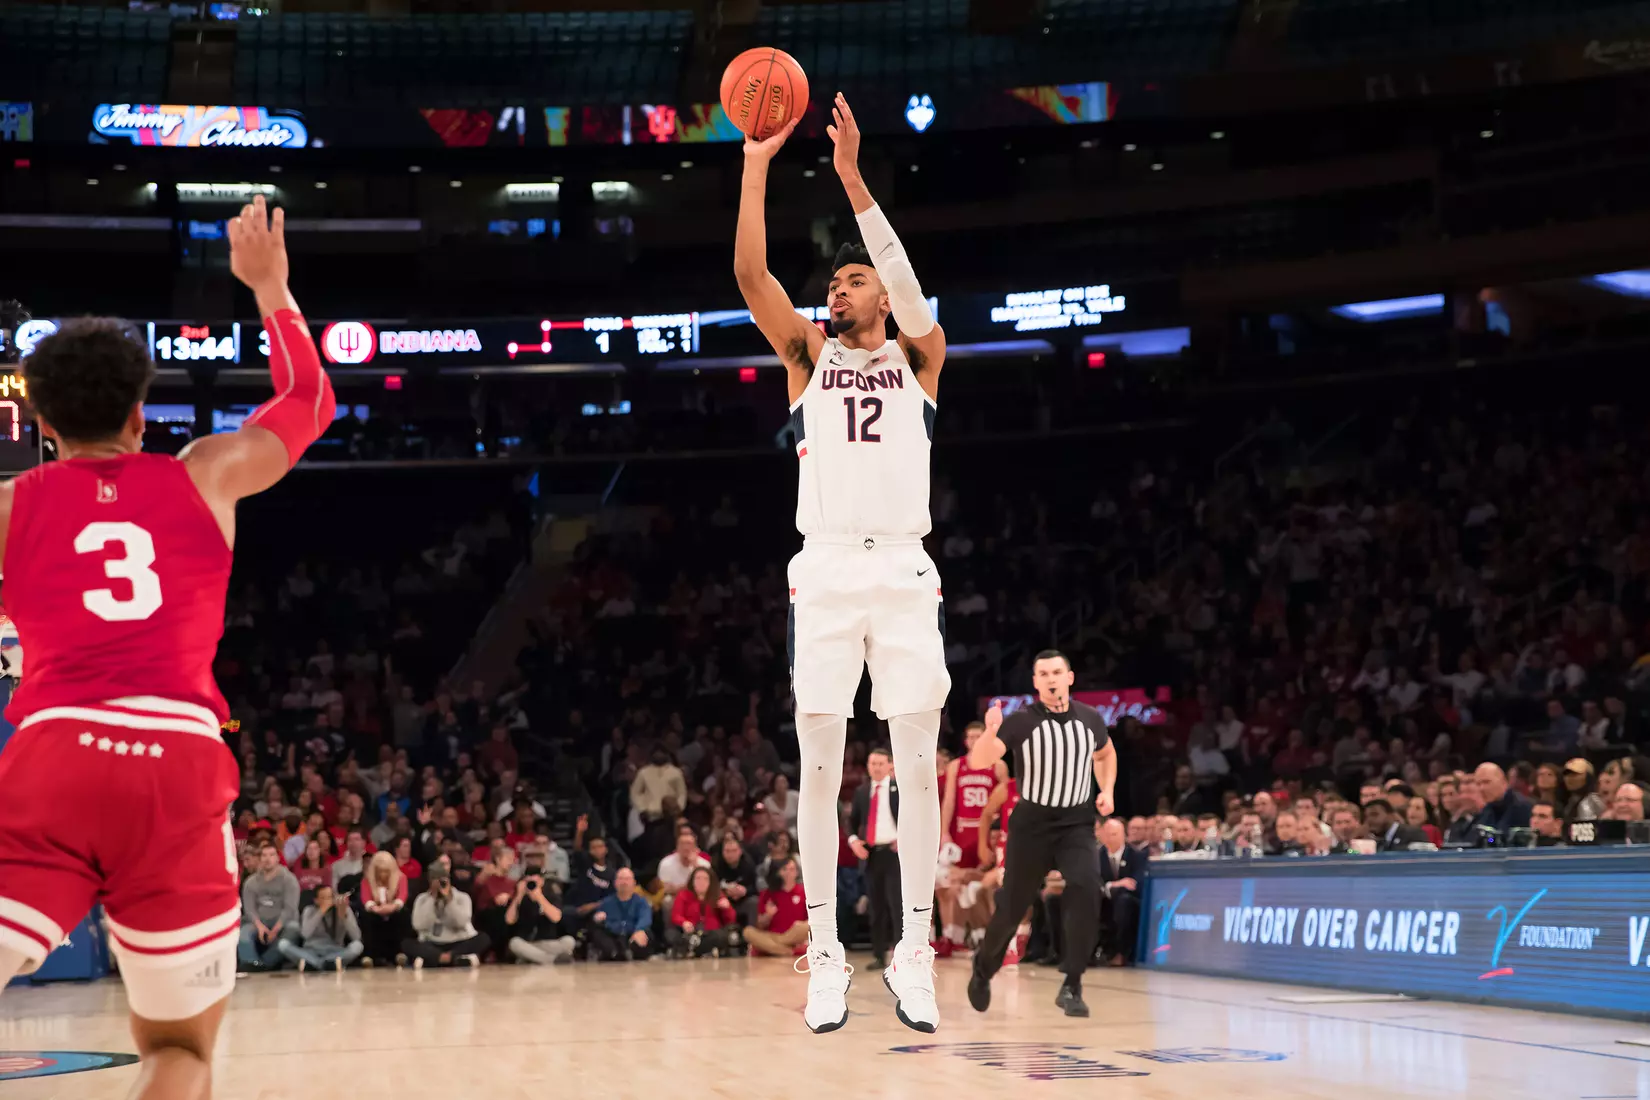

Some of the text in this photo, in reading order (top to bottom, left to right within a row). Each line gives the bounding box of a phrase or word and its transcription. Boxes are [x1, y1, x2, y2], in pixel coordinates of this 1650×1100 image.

[739, 75, 763, 131] PALDING
[99, 103, 184, 137] Jimmy
[200, 119, 293, 148] Classic
[180, 324, 209, 339] 2nd
[379, 329, 482, 353] INDIANA
[595, 331, 609, 353] 1
[155, 336, 235, 360] 13:44
[821, 368, 904, 392] UCONN
[843, 396, 883, 442] 12
[73, 521, 163, 622] 3
[963, 786, 989, 808] 50
[1223, 906, 1460, 956] VICTORY OVER CANCER
